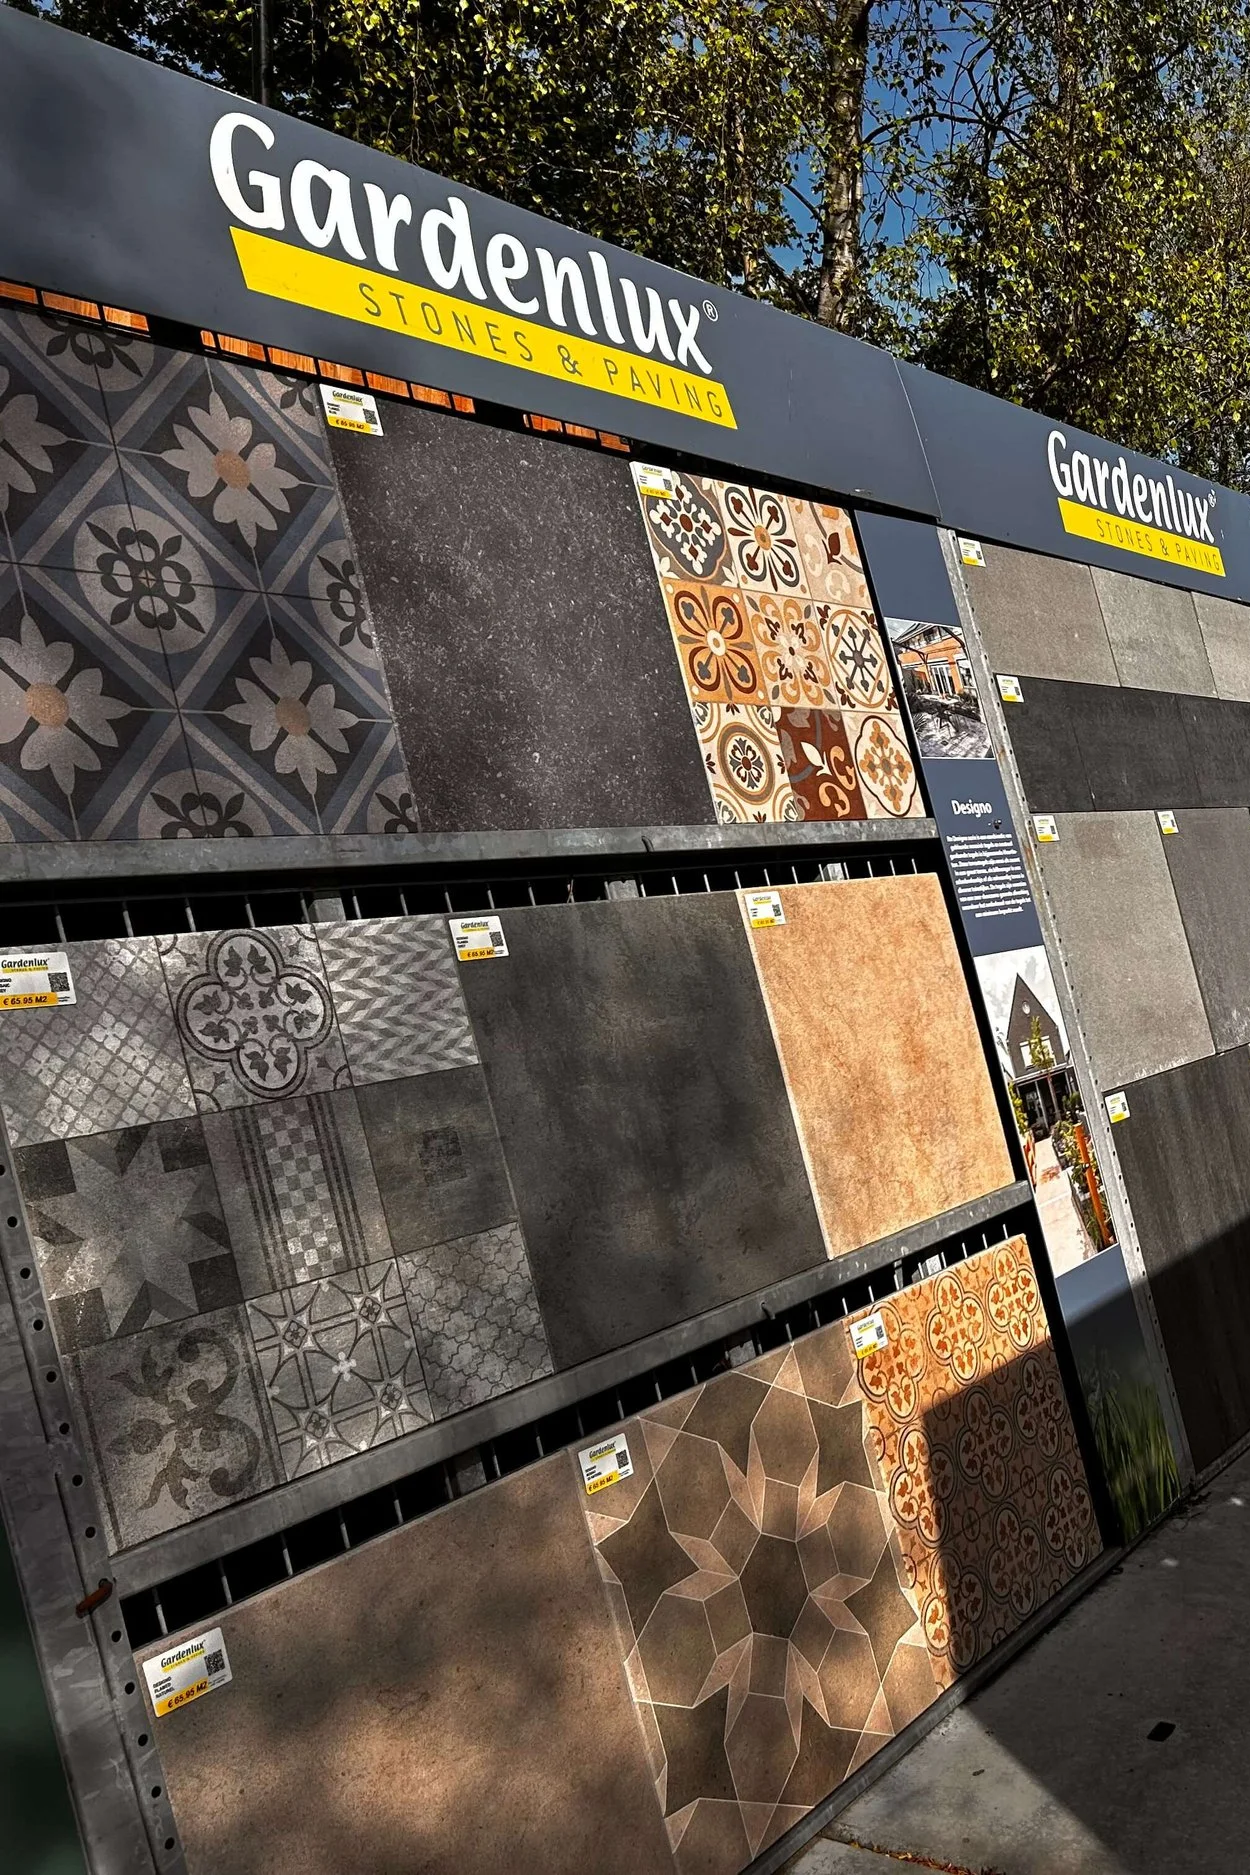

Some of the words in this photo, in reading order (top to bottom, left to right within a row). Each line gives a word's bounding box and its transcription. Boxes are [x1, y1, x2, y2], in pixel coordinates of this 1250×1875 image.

[359, 282, 533, 362] STONES
[557, 343, 582, 376] &
[603, 357, 723, 418] PAVING
[1096, 518, 1153, 552] STONES
[1159, 538, 1169, 556] &
[1175, 542, 1220, 571] PAVING
[951, 799, 993, 818] Designo
[1, 957, 49, 969] Gardenlux
[3, 998, 9, 1006] €
[35, 995, 48, 1003] M2
[160, 1640, 206, 1668] Gardenlux
[167, 1699, 173, 1708] €
[196, 1680, 208, 1693] M2
